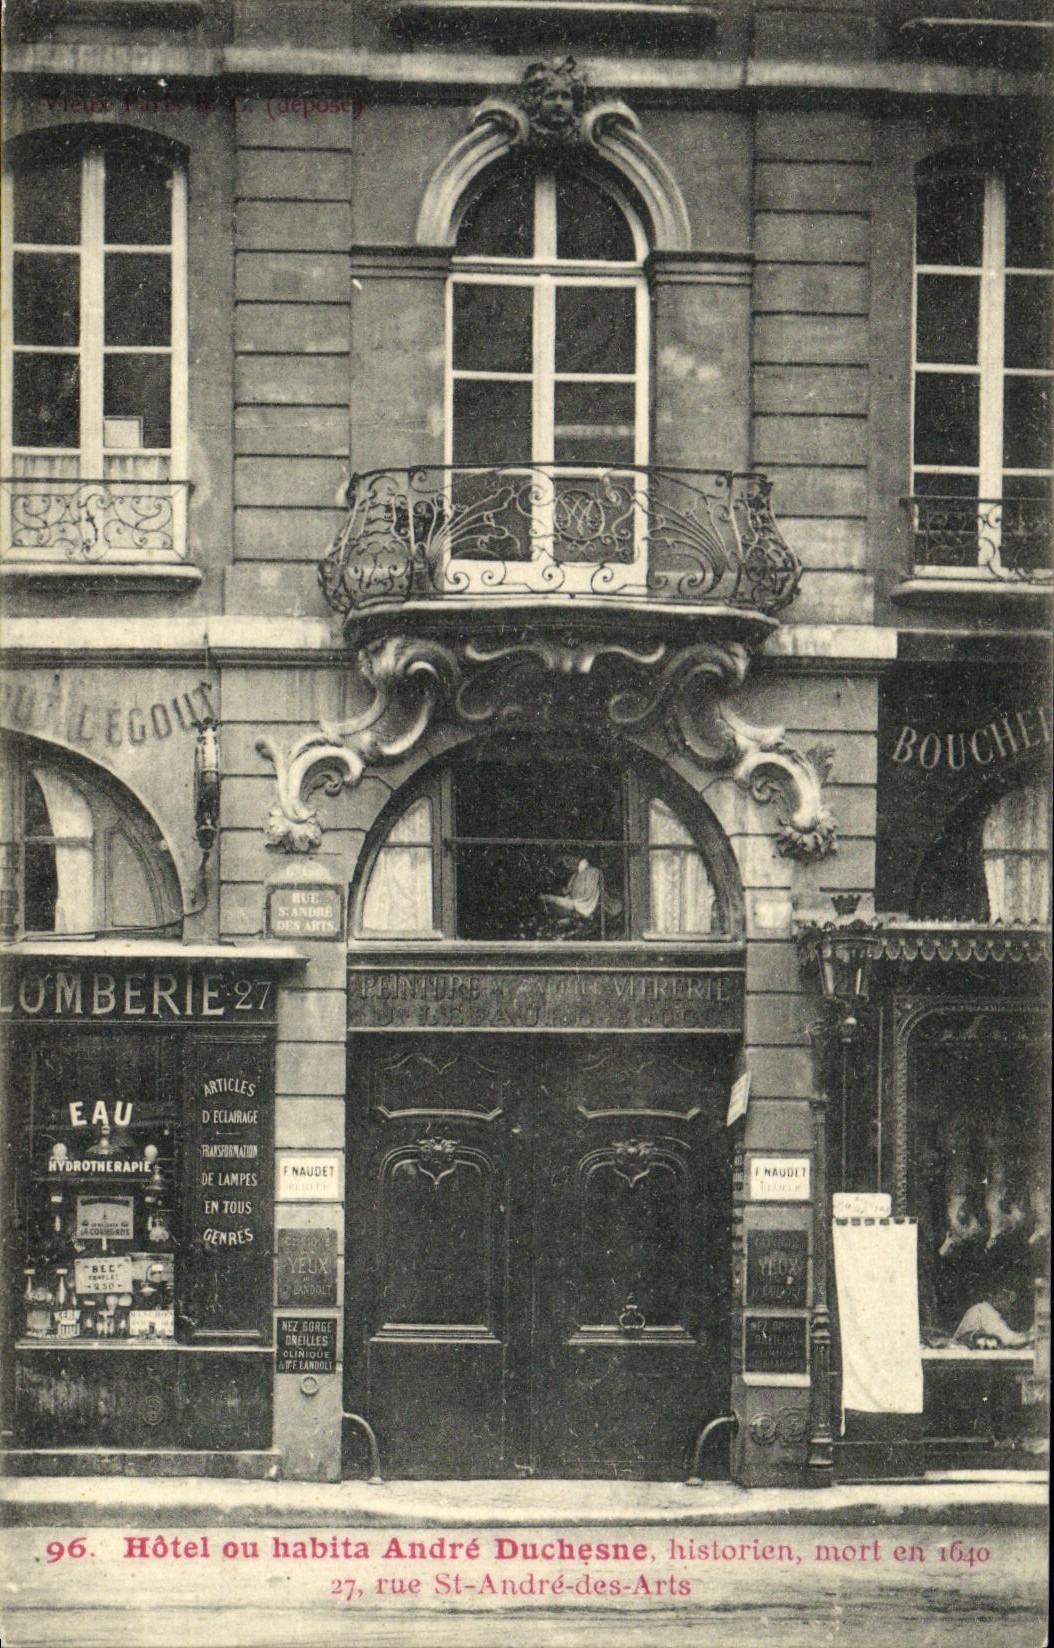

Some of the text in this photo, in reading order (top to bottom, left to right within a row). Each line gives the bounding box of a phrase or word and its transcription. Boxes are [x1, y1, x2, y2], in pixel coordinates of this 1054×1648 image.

[891, 707, 1052, 771] BOUCHE
[292, 892, 319, 904] RUE
[276, 920, 300, 931] DES
[360, 976, 480, 1000] PEINTURE
[611, 976, 731, 1001] VITRERIE
[234, 980, 272, 1011] 27
[204, 1078, 256, 1098] ARTICLES
[69, 1101, 133, 1126] EAU
[201, 1145, 257, 1158] TRANSFORMATION
[49, 1160, 151, 1173] HYDROTHERAPIE
[292, 1166, 335, 1177] NAUDET
[764, 1167, 806, 1177] NAUDET
[202, 1173, 257, 1187] DE LAMPES
[205, 1201, 252, 1214] EN TOUS
[203, 1228, 253, 1246] GENRES
[287, 1257, 329, 1274] YEUX
[293, 1284, 332, 1295] LANDOLT
[281, 1321, 332, 1332] NEZ GORGE
[285, 1335, 329, 1346] OREILLES
[283, 1351, 332, 1359] CLINIQUE
[299, 1360, 333, 1370] LANDOLT
